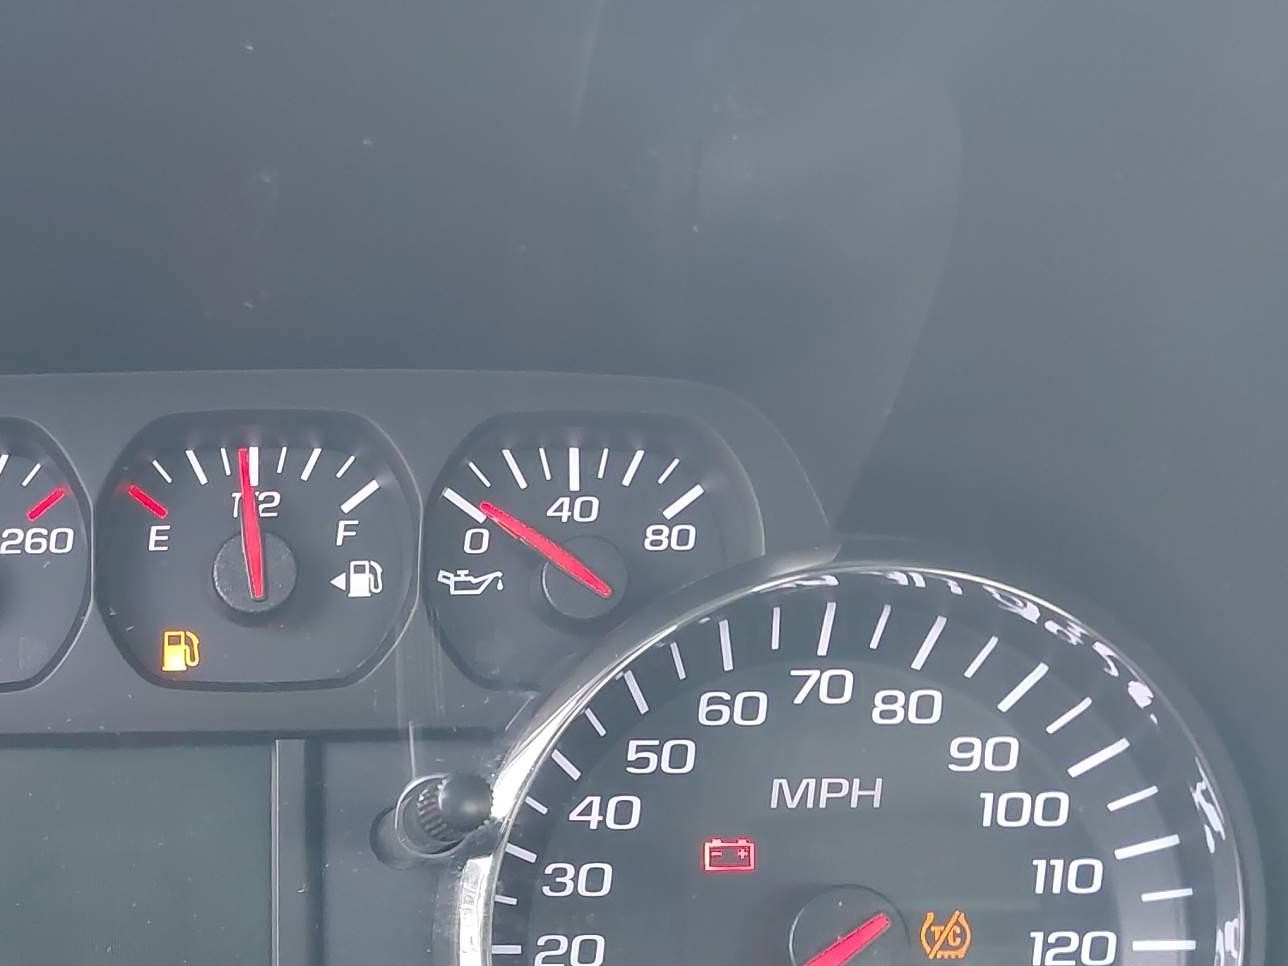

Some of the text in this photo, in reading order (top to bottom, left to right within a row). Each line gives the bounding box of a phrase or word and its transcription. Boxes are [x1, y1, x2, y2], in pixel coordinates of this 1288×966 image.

[230, 491, 281, 517] 12
[546, 496, 601, 523] 40
[0, 527, 75, 555] 260
[148, 525, 170, 552] E
[335, 520, 360, 546] F
[463, 529, 490, 555] 0
[643, 524, 696, 551] 80
[788, 668, 854, 706] 70
[697, 690, 768, 726] 60
[871, 689, 943, 726] 80
[624, 739, 696, 775] 50
[947, 736, 1020, 772] 90
[770, 777, 884, 810] MPH
[979, 791, 1071, 828] 100
[568, 794, 641, 831] 40
[541, 862, 613, 898] 30
[1031, 858, 1104, 894] 110
[1028, 931, 1117, 966] 120
